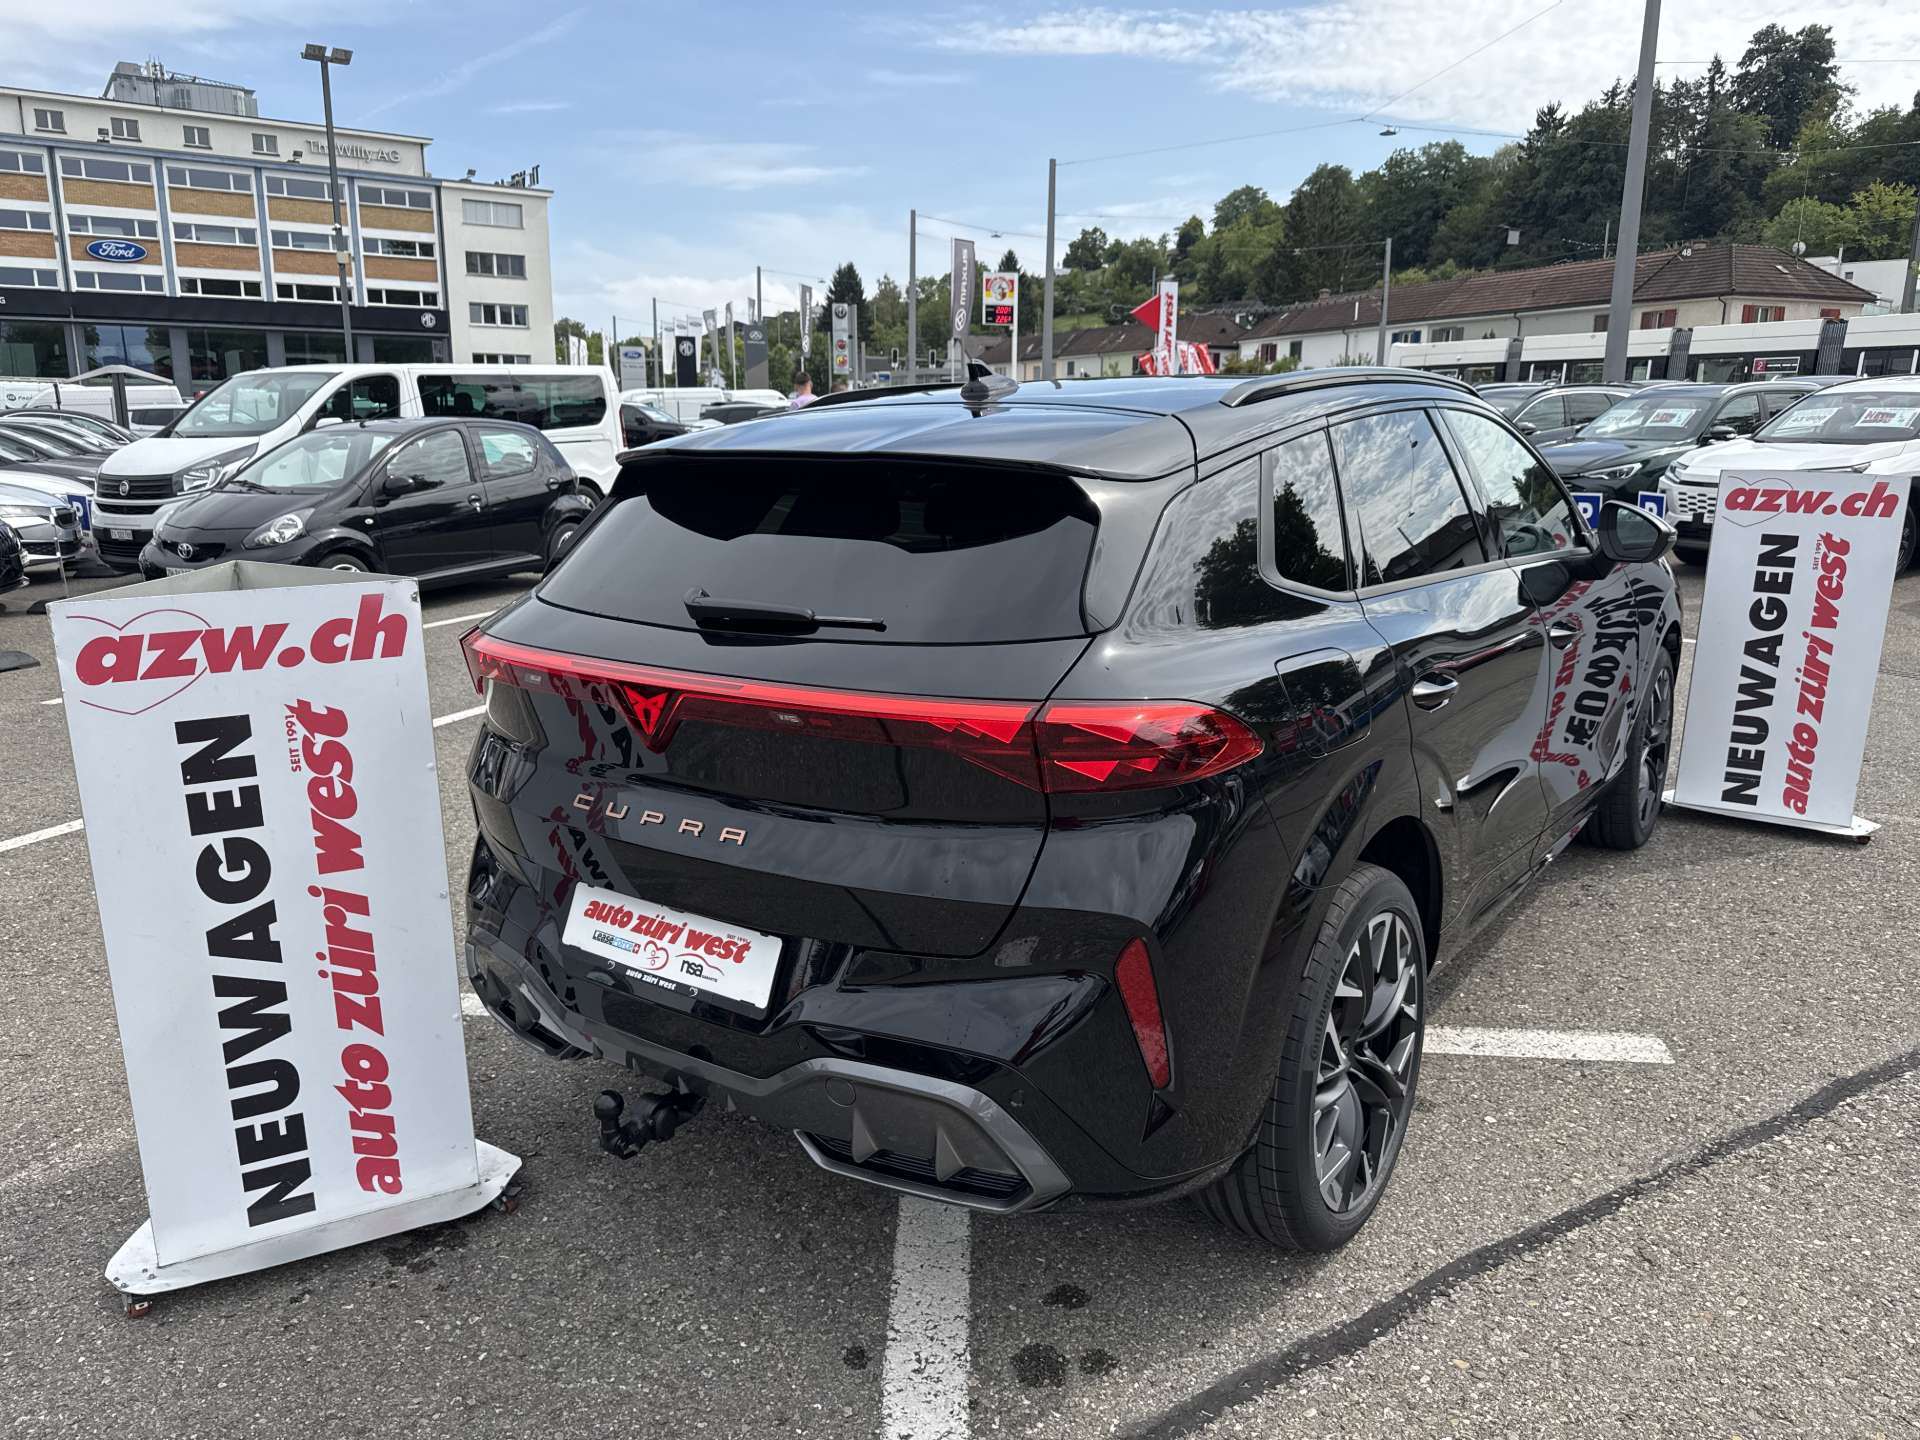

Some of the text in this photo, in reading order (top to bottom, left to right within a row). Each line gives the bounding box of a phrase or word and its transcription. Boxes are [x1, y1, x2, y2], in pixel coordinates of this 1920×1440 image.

[336, 143, 373, 162] Willy
[378, 149, 401, 162] AG
[98, 242, 135, 258] Ford
[421, 312, 436, 328] MG
[678, 340, 694, 356] MG
[1724, 481, 1900, 518] azw.ch
[1812, 538, 1823, 571] SEIT 1991
[76, 593, 408, 686] azw.ch
[1721, 533, 1800, 806] NEUWAGEN
[1783, 531, 1851, 815] auto züri west
[284, 714, 302, 773] SEIT 1991
[572, 793, 747, 846] CUPRA
[284, 698, 403, 1195] auto züri west
[583, 900, 752, 964] auto züri west
[174, 714, 316, 1227] NEUWAGEN
[625, 968, 677, 991] auto züri west
[680, 959, 703, 978] nsa
[1309, 966, 1338, 1062] Continental
